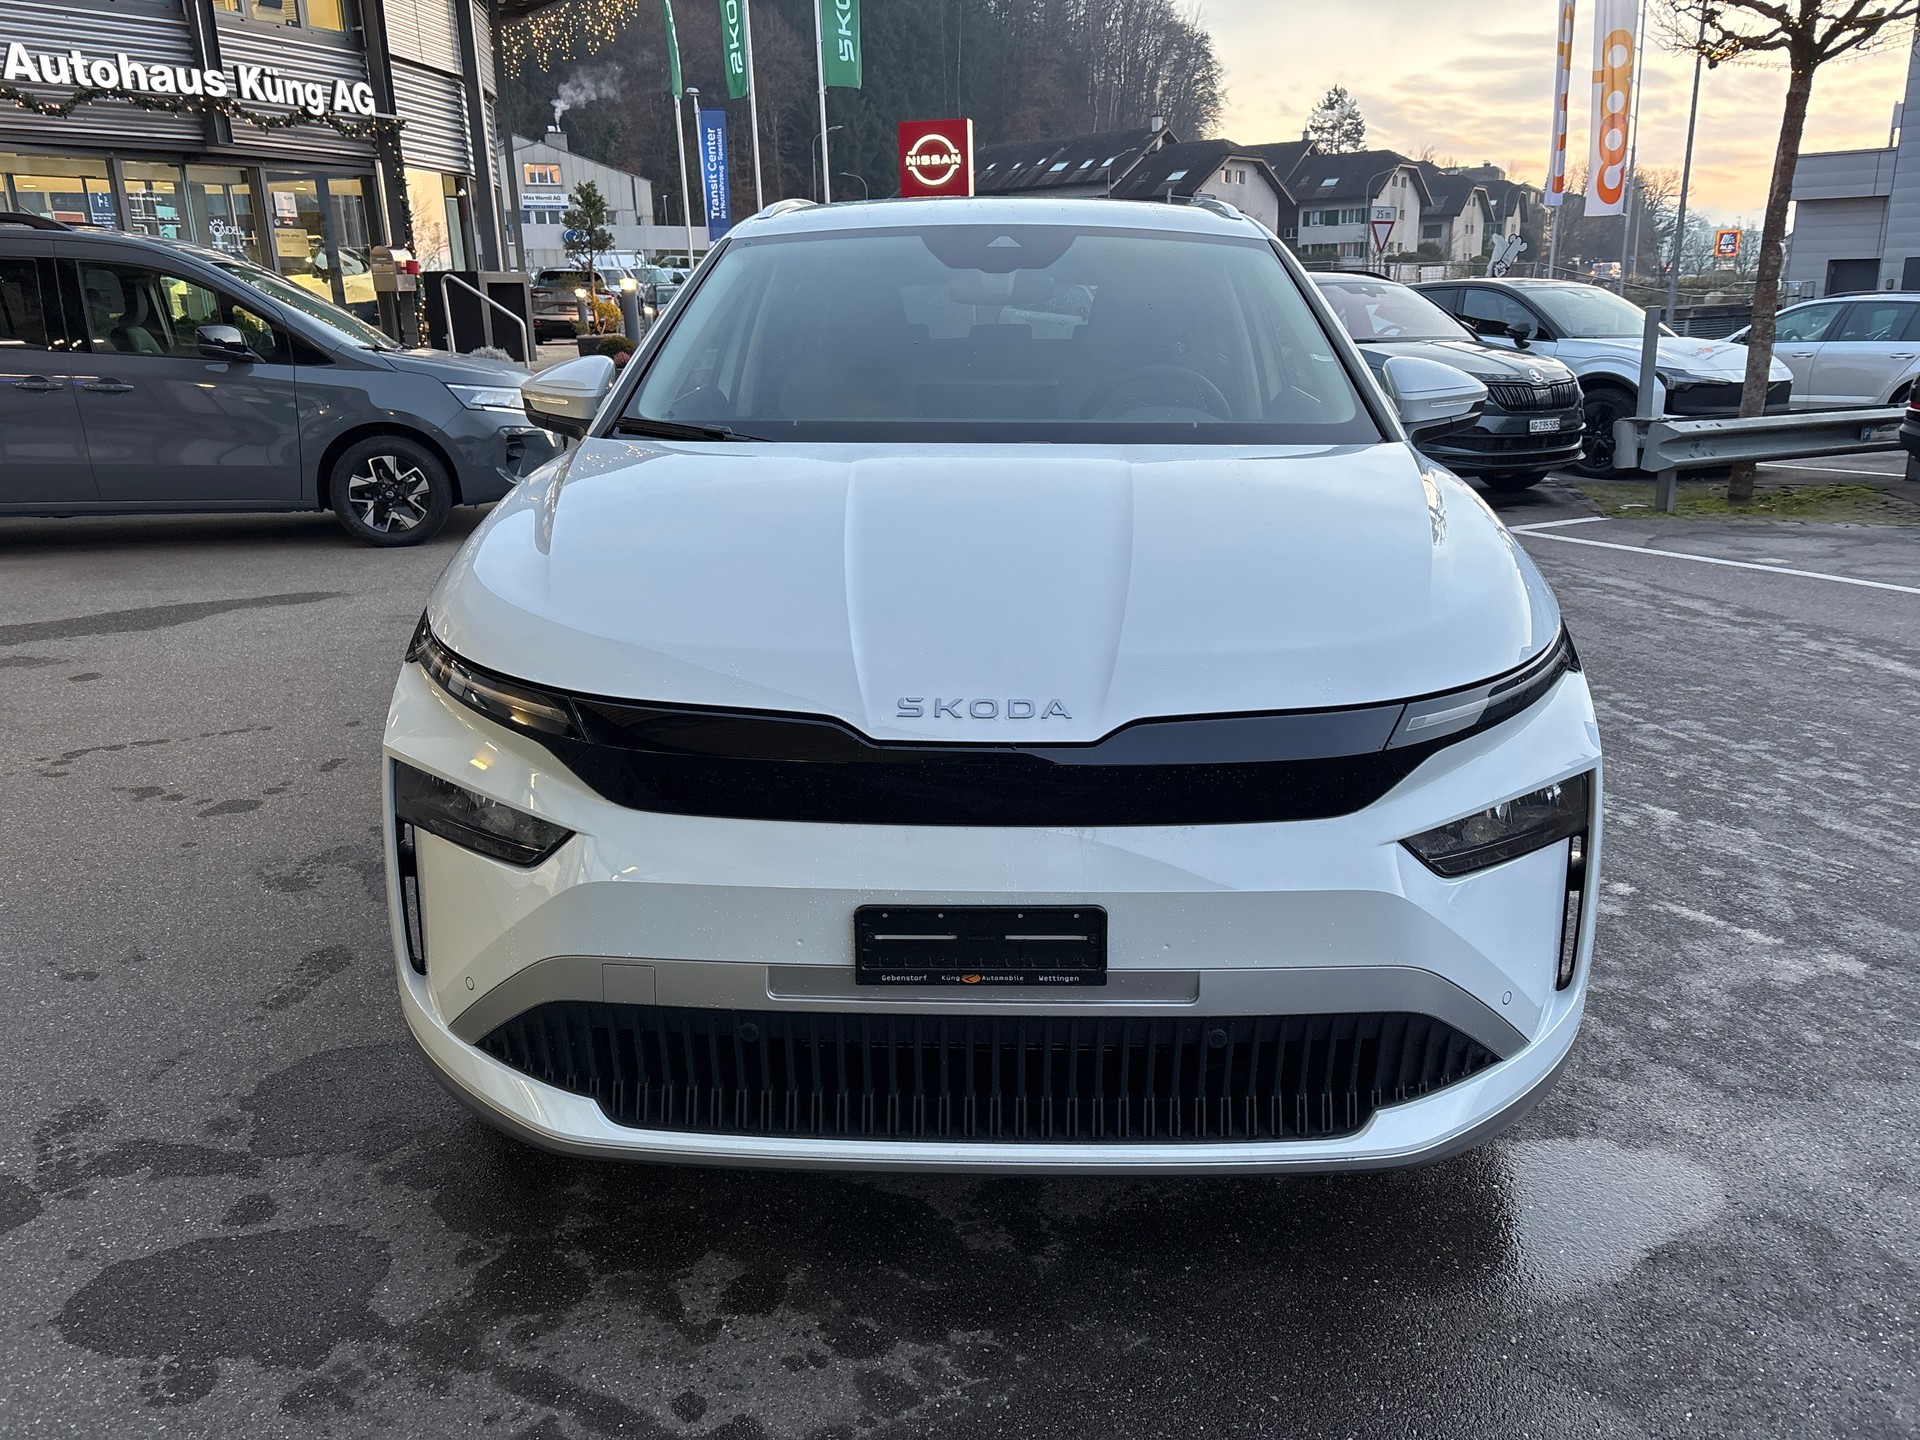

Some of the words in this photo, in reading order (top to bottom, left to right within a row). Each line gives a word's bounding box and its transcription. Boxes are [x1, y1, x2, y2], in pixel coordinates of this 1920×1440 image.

[4, 42, 228, 98] Autohaus
[237, 65, 324, 115] Küng
[333, 80, 375, 115] AG
[1592, 29, 1634, 205] coop
[706, 128, 717, 171] Center
[716, 128, 724, 160] Spezialist
[905, 153, 961, 166] NISSAN
[708, 173, 720, 219] Transit
[718, 165, 726, 208] Nutzfahrzeug
[1376, 210, 1384, 219] 25
[896, 697, 1073, 719] SKODA
[1038, 974, 1080, 982] Wettingen
